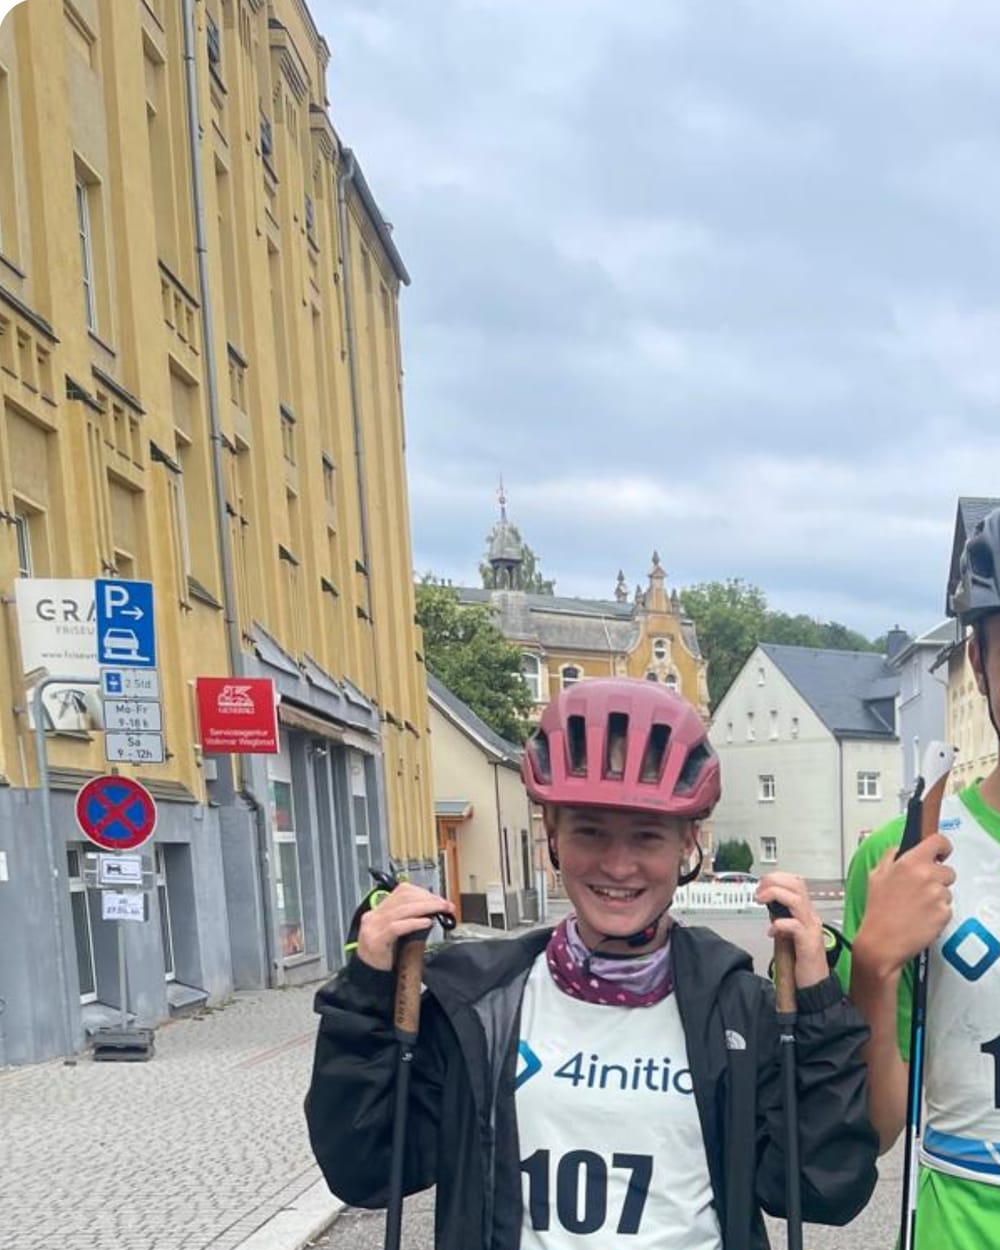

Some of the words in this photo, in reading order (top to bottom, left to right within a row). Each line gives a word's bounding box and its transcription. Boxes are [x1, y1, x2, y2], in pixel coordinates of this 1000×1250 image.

[105, 585, 129, 619] P
[127, 737, 141, 747] Sa
[519, 1148, 654, 1235] 107
